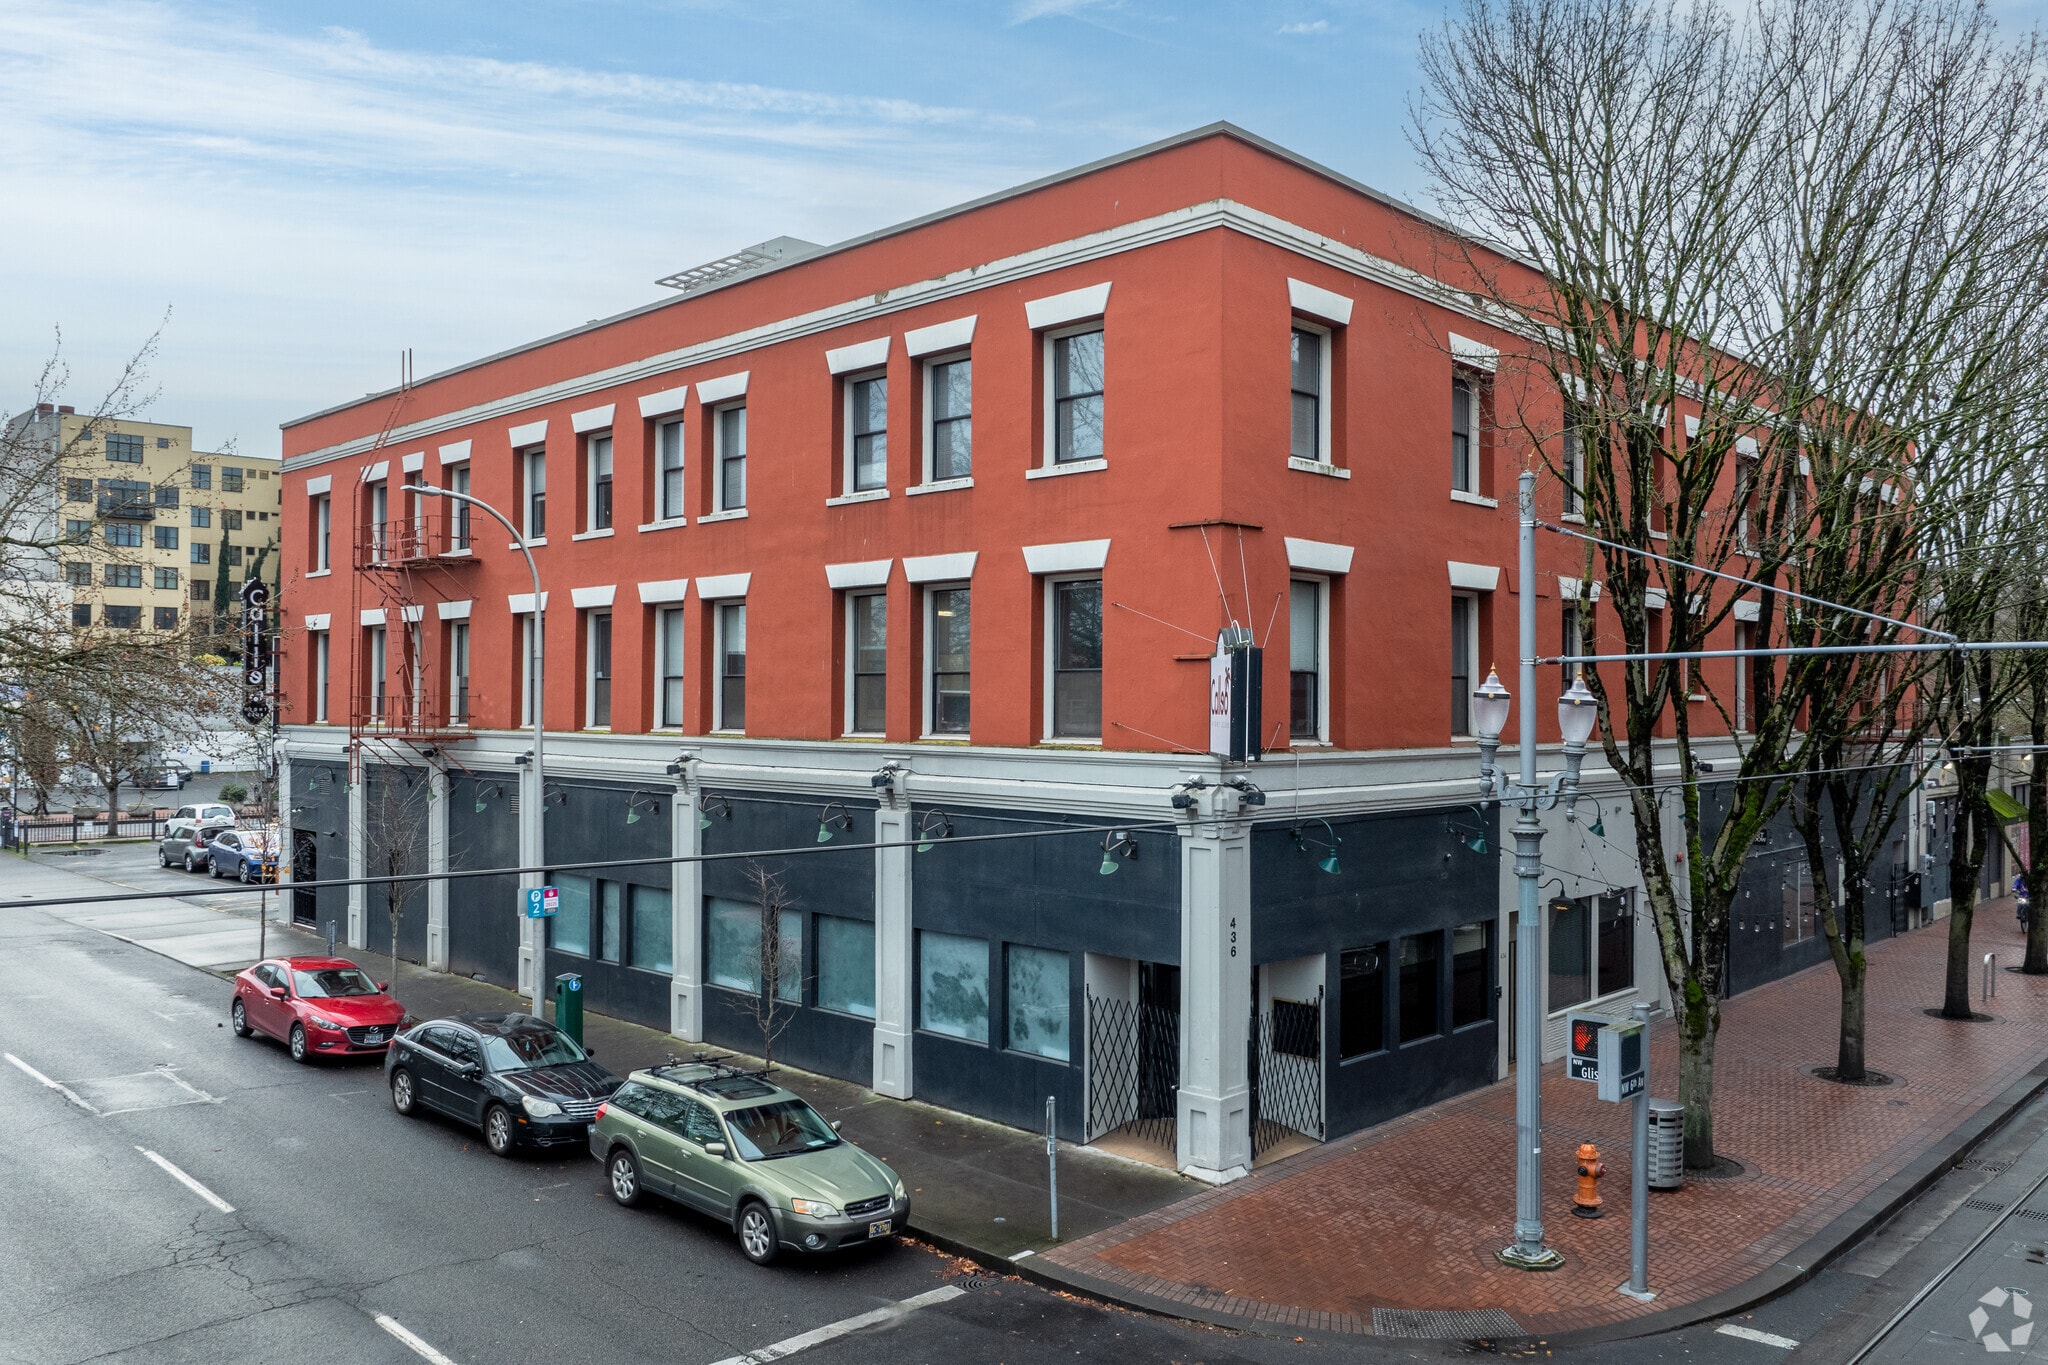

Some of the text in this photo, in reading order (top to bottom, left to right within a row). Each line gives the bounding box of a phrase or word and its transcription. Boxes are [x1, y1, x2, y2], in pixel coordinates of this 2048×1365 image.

[533, 903, 540, 914] 2
[1572, 1058, 1583, 1066] NW
[1581, 1066, 1598, 1080] Glis
